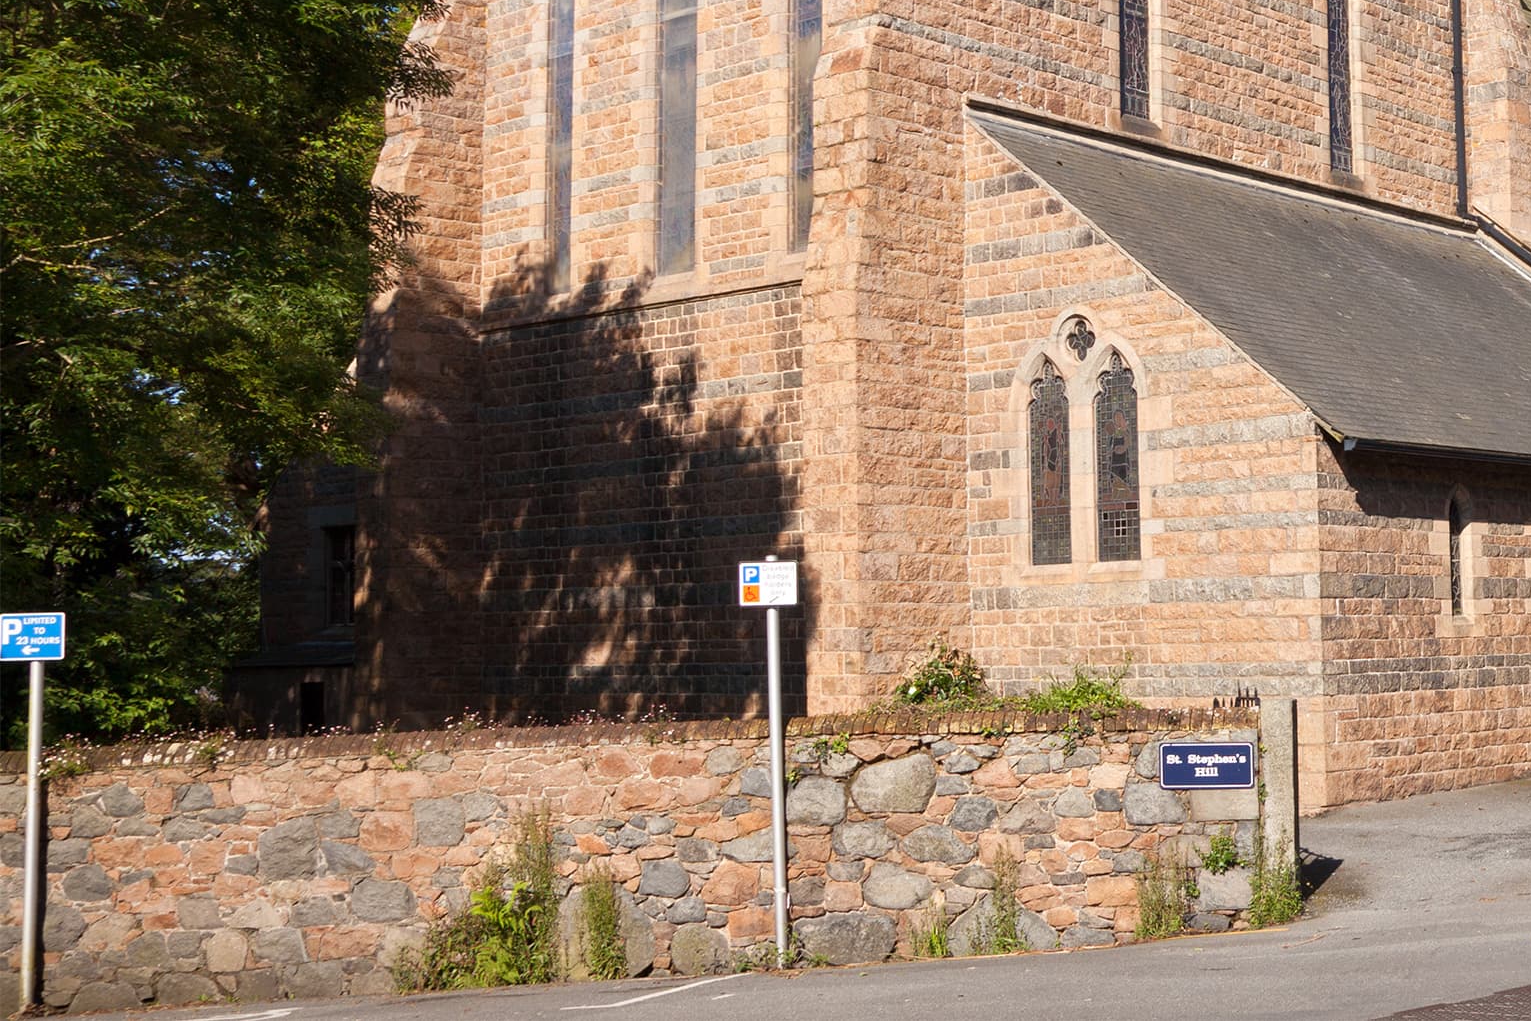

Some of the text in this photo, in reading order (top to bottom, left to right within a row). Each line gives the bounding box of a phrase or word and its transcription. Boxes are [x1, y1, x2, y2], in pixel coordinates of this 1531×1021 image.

[745, 568, 758, 582] P
[23, 616, 57, 625] LIMITED
[2, 618, 22, 645] P
[33, 626, 47, 635] TO
[30, 636, 61, 645] HOURS
[1166, 753, 1247, 766] St. Stephen's
[1194, 767, 1219, 777] Hill
